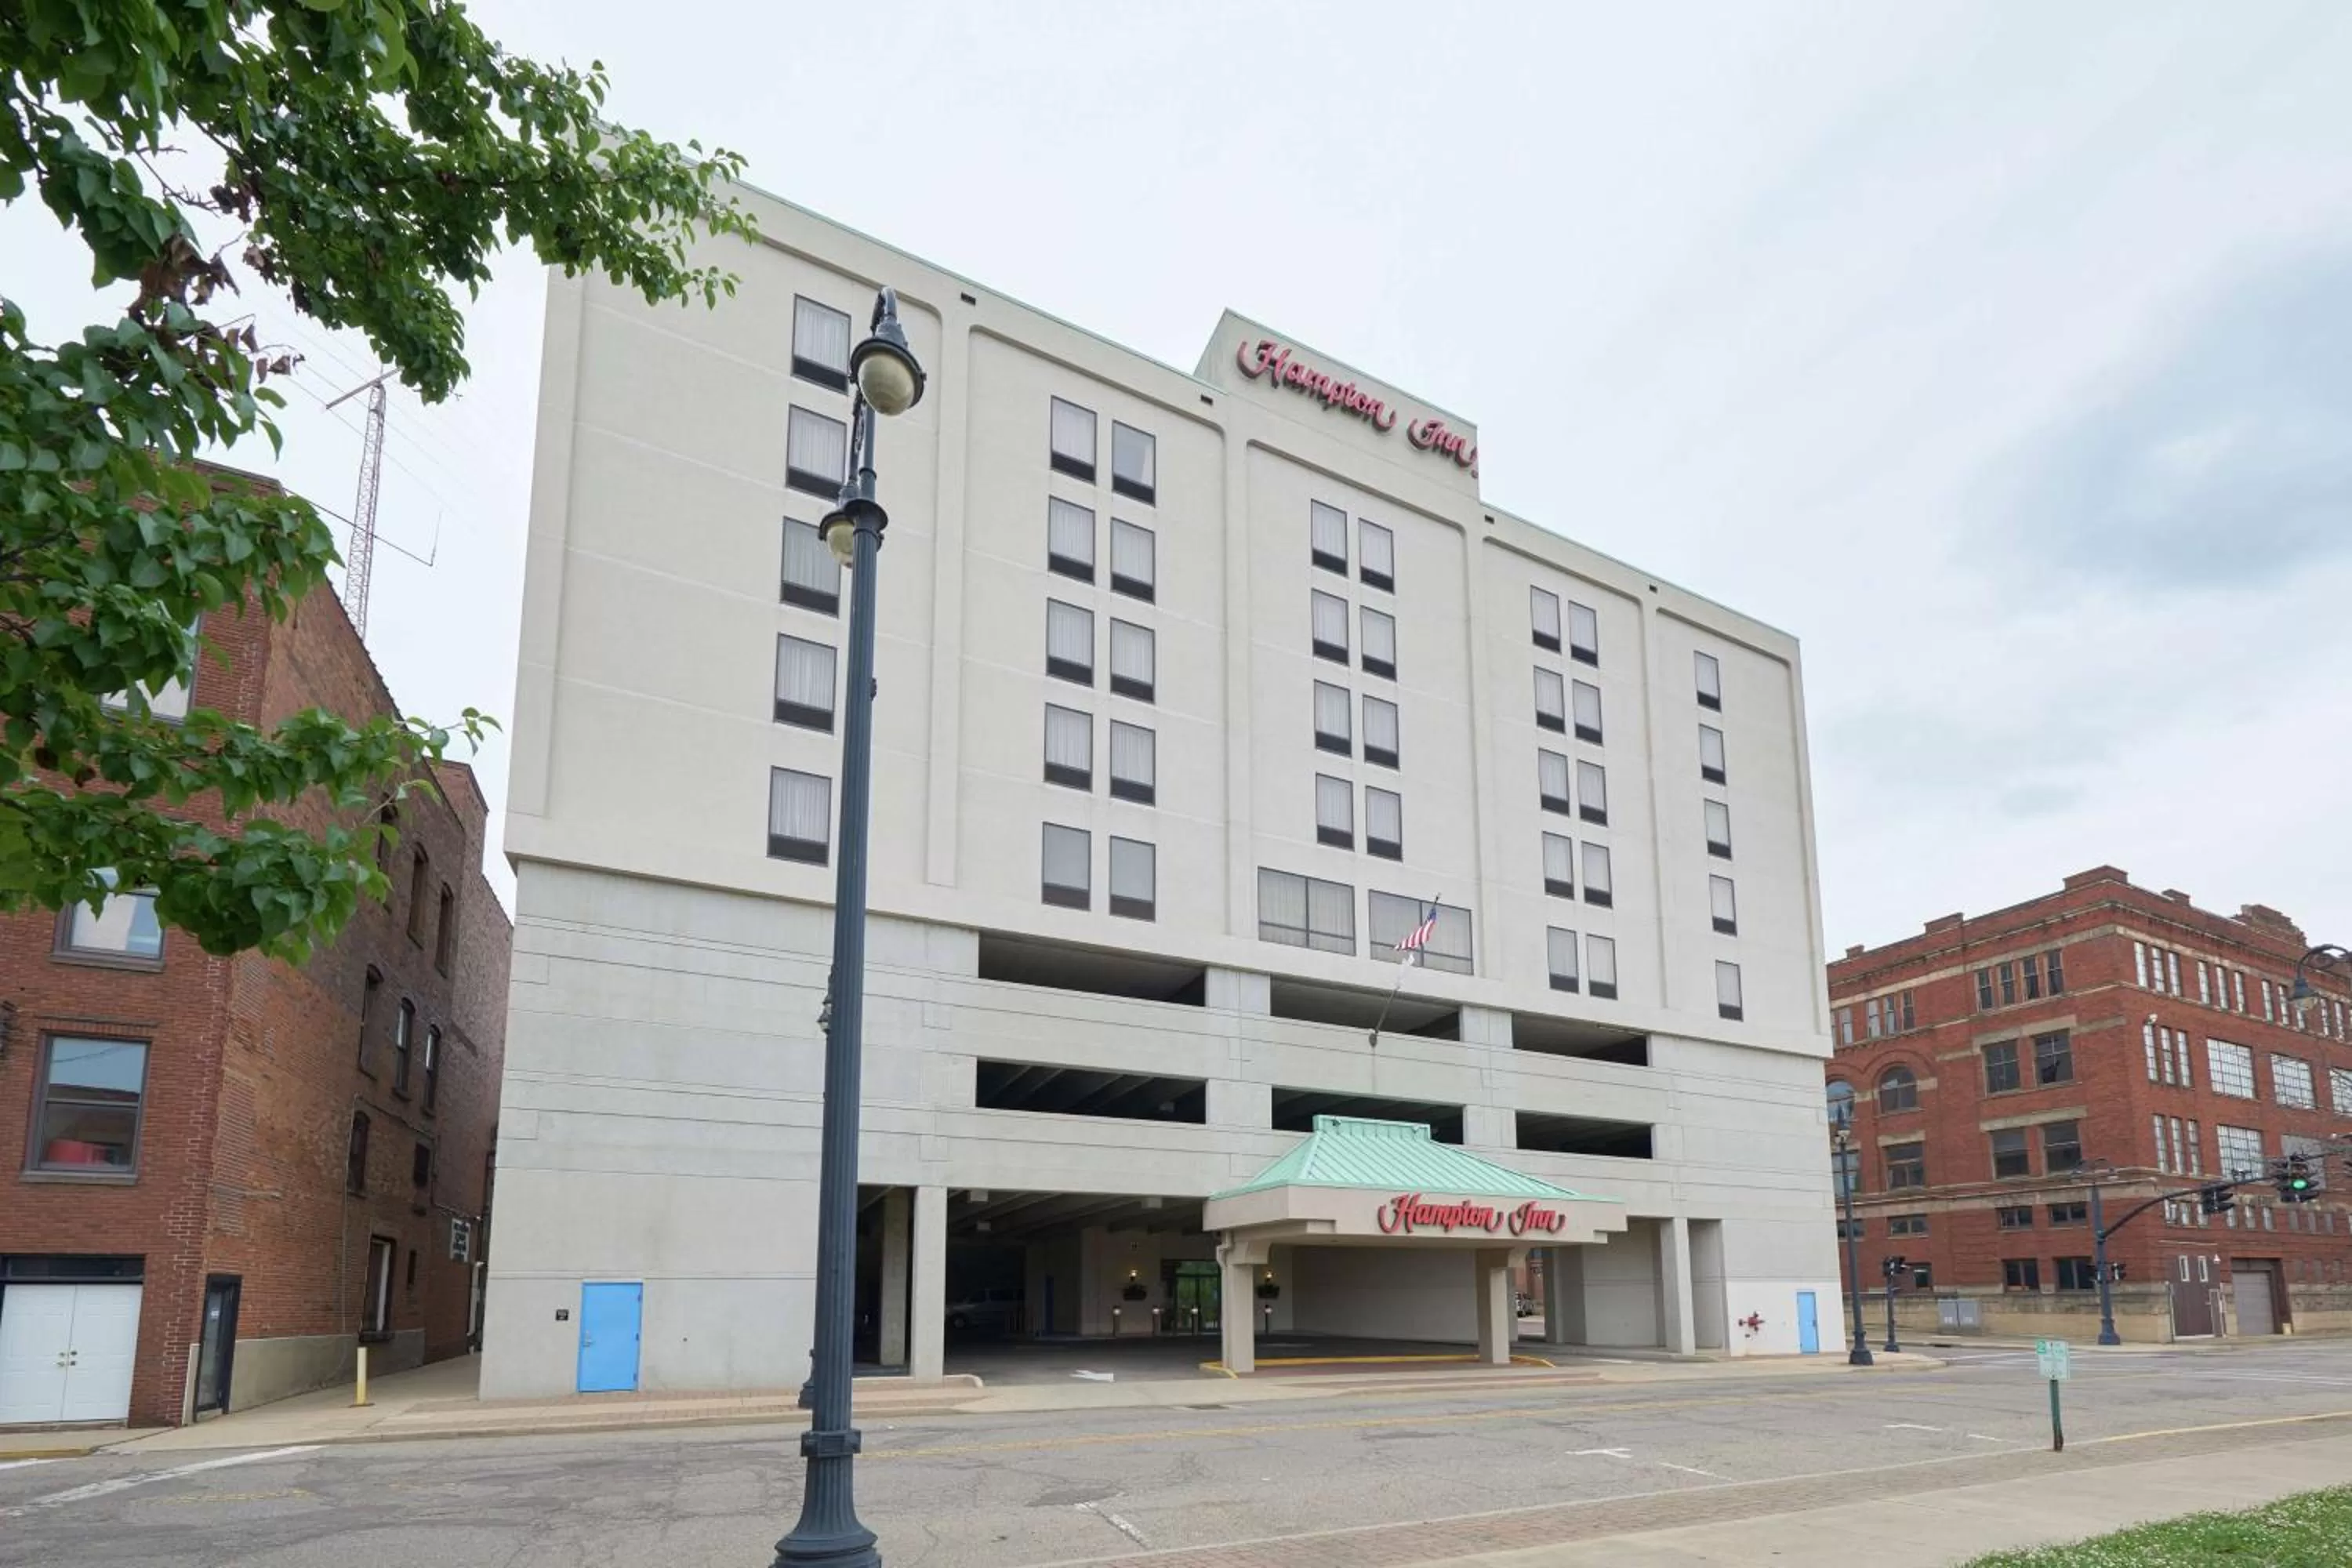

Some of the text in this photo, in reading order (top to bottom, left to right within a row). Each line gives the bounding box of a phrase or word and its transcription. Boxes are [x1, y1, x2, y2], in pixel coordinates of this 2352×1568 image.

[1236, 339, 1479, 467] Hampton Inn
[1378, 1192, 1566, 1236] Hampton Inn
